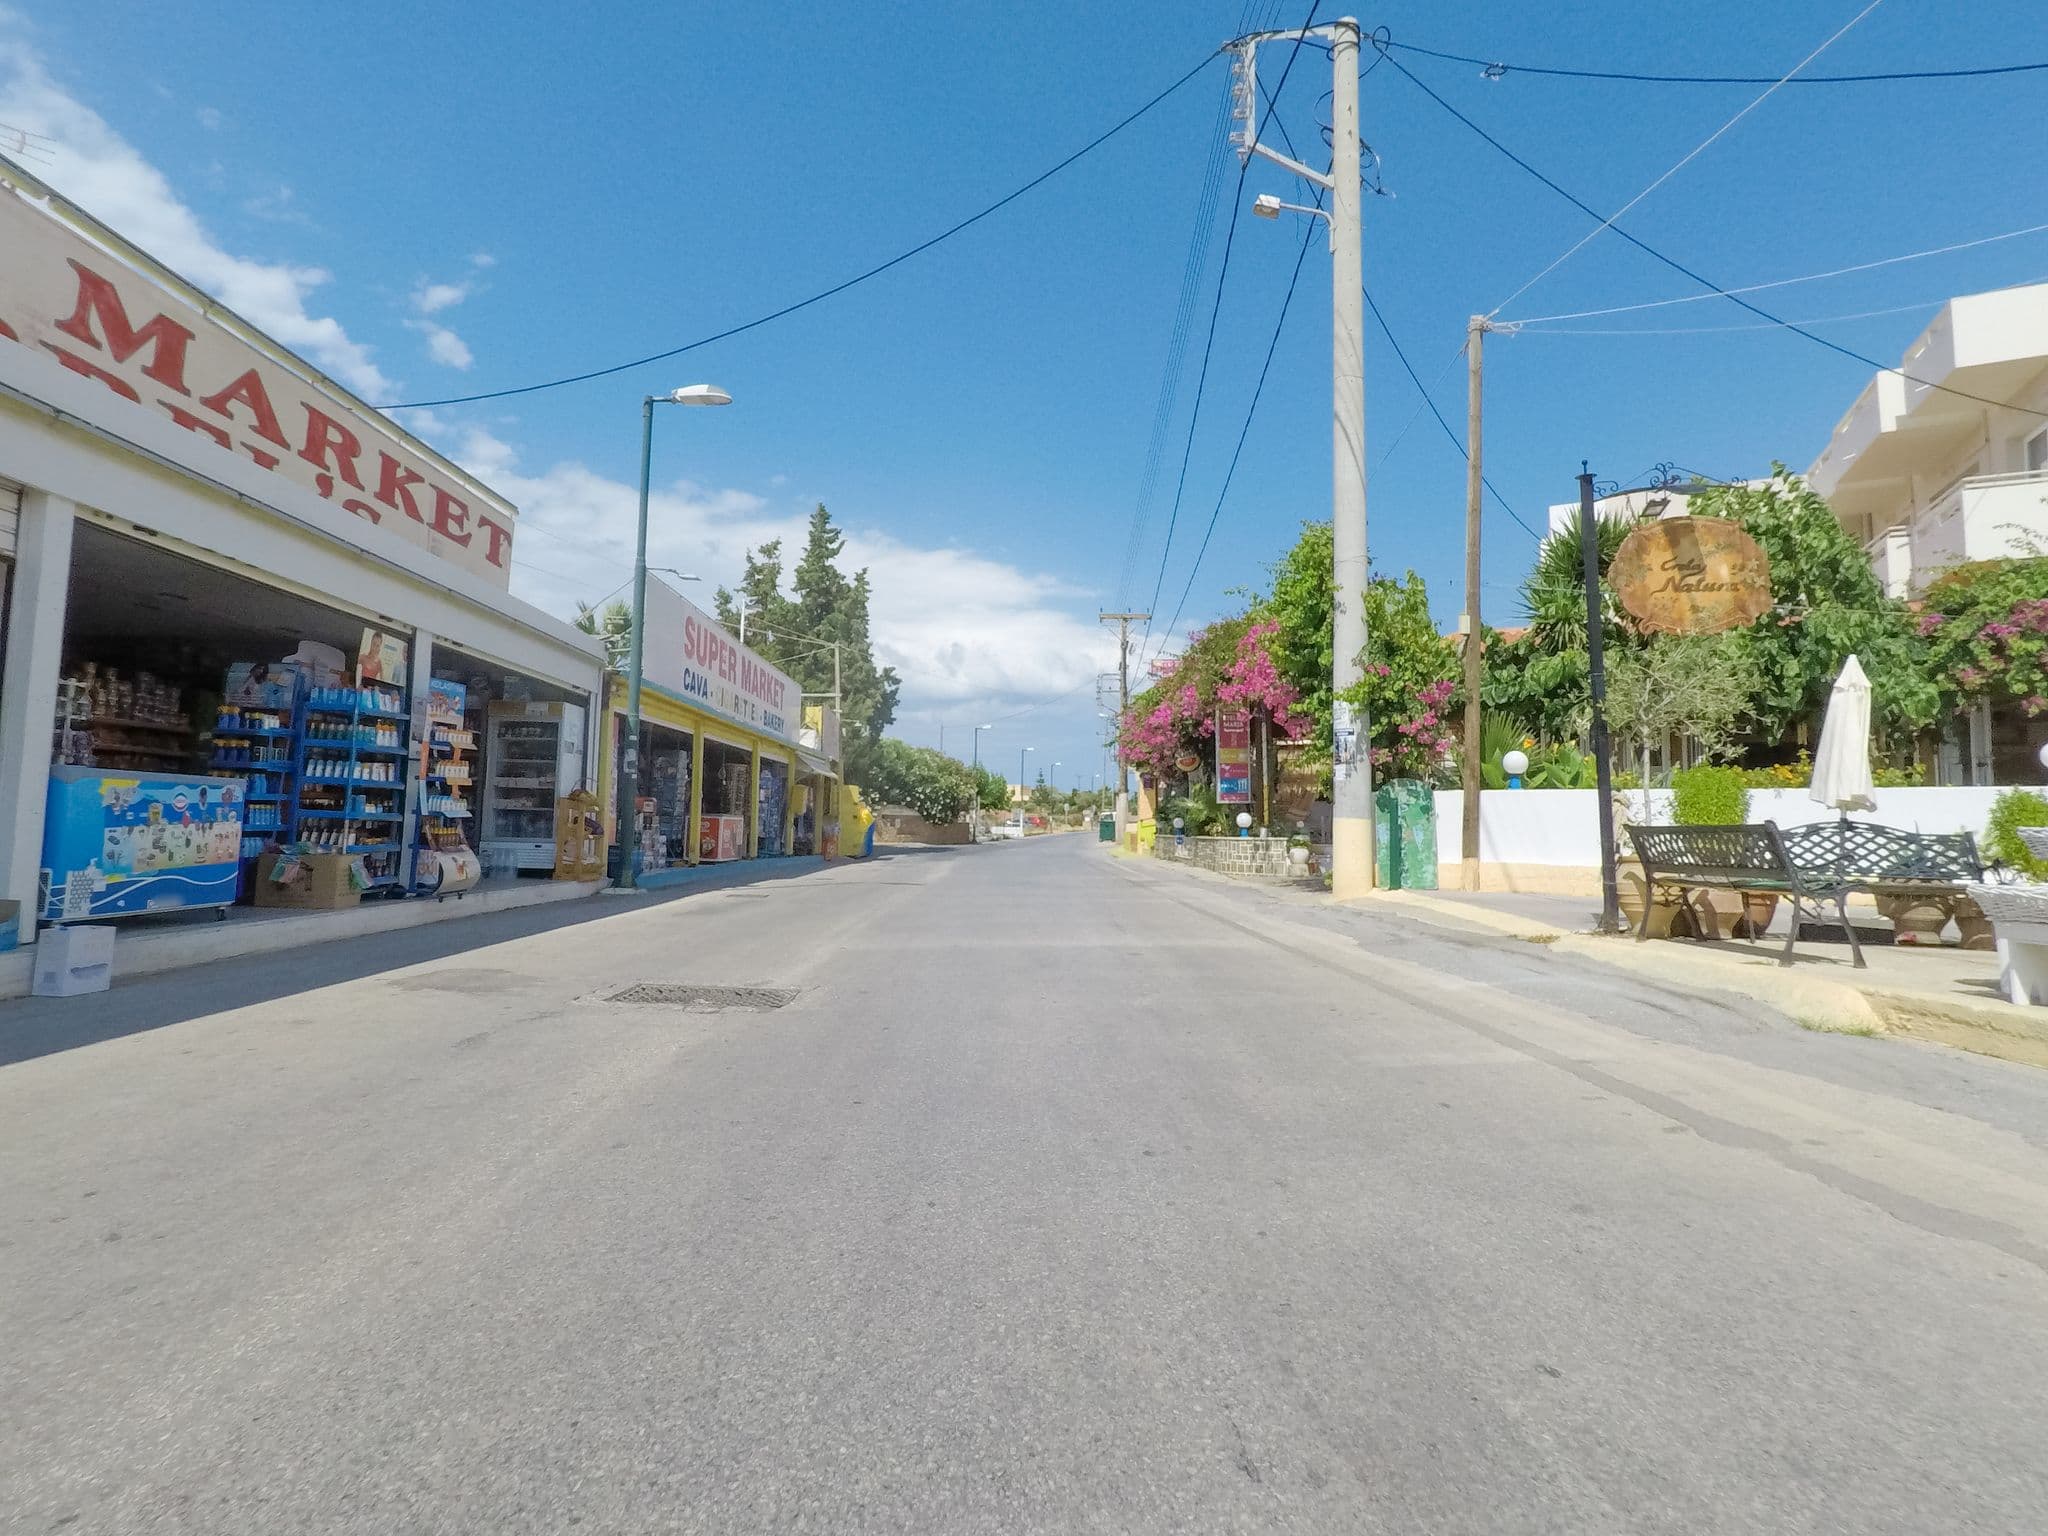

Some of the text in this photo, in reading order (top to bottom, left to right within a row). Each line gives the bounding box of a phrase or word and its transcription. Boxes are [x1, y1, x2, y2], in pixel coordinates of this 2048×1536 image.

[54, 257, 511, 569] MARKET
[683, 667, 785, 734] CAVA BAKERY
[684, 615, 737, 685] SUPER
[741, 655, 785, 711] MARKET
